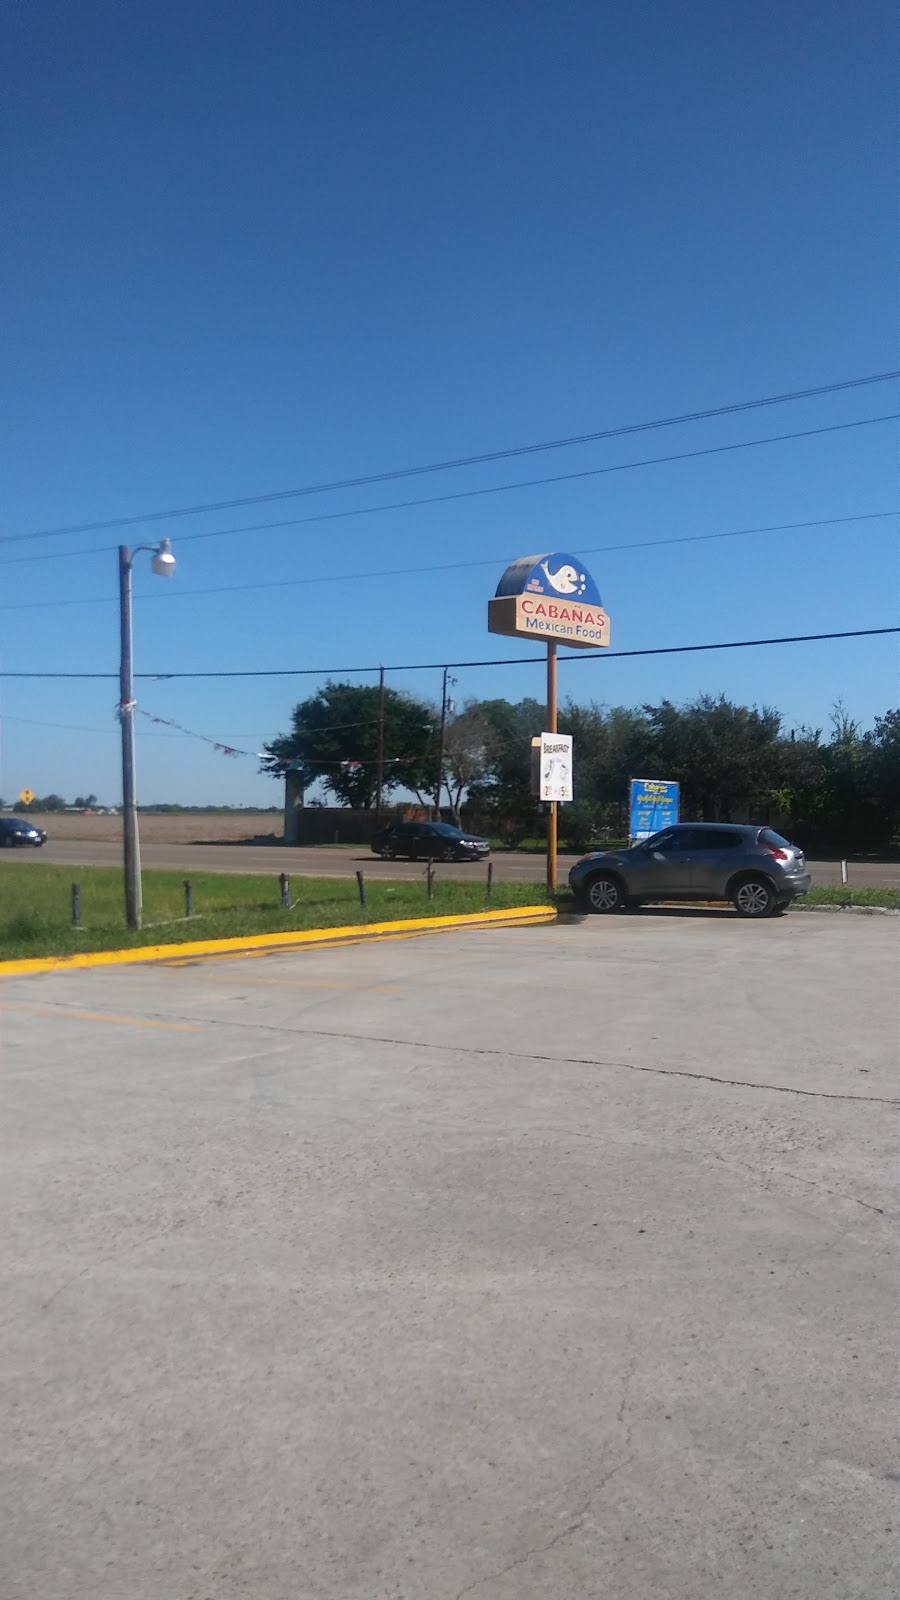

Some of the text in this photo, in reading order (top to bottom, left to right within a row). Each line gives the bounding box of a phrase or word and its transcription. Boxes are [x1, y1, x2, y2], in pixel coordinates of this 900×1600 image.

[521, 600, 605, 627] CABAÑAS
[526, 617, 602, 639] Mexican Food
[543, 743, 570, 754] BREAKFAST
